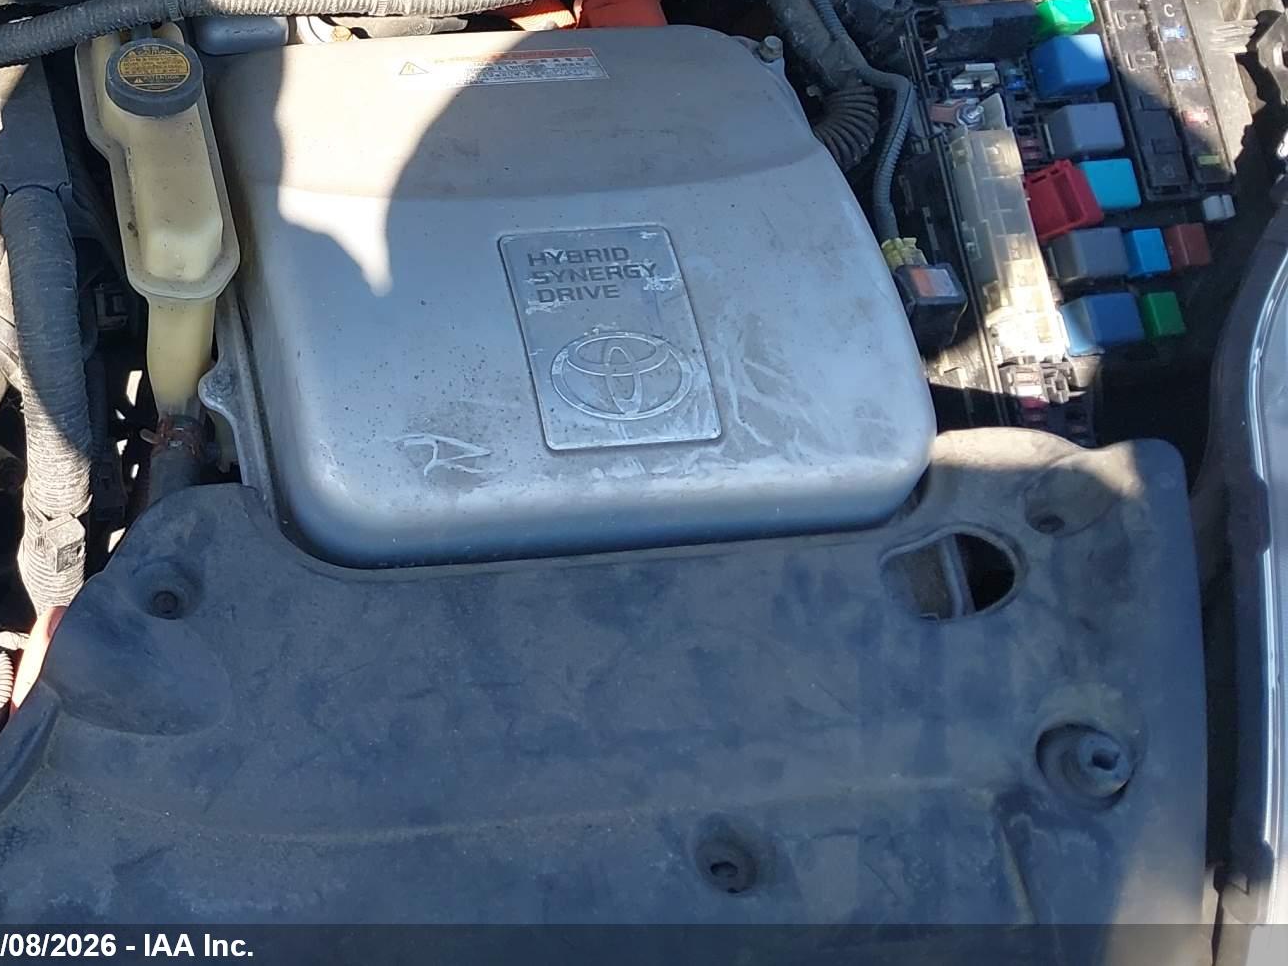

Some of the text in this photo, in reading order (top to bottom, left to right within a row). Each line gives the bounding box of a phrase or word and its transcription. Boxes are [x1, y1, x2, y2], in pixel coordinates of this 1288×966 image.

[1163, 3, 1176, 18] C
[527, 247, 630, 267] HYBRID
[532, 262, 657, 285] SYNERGY
[536, 284, 621, 303] DRIVE
